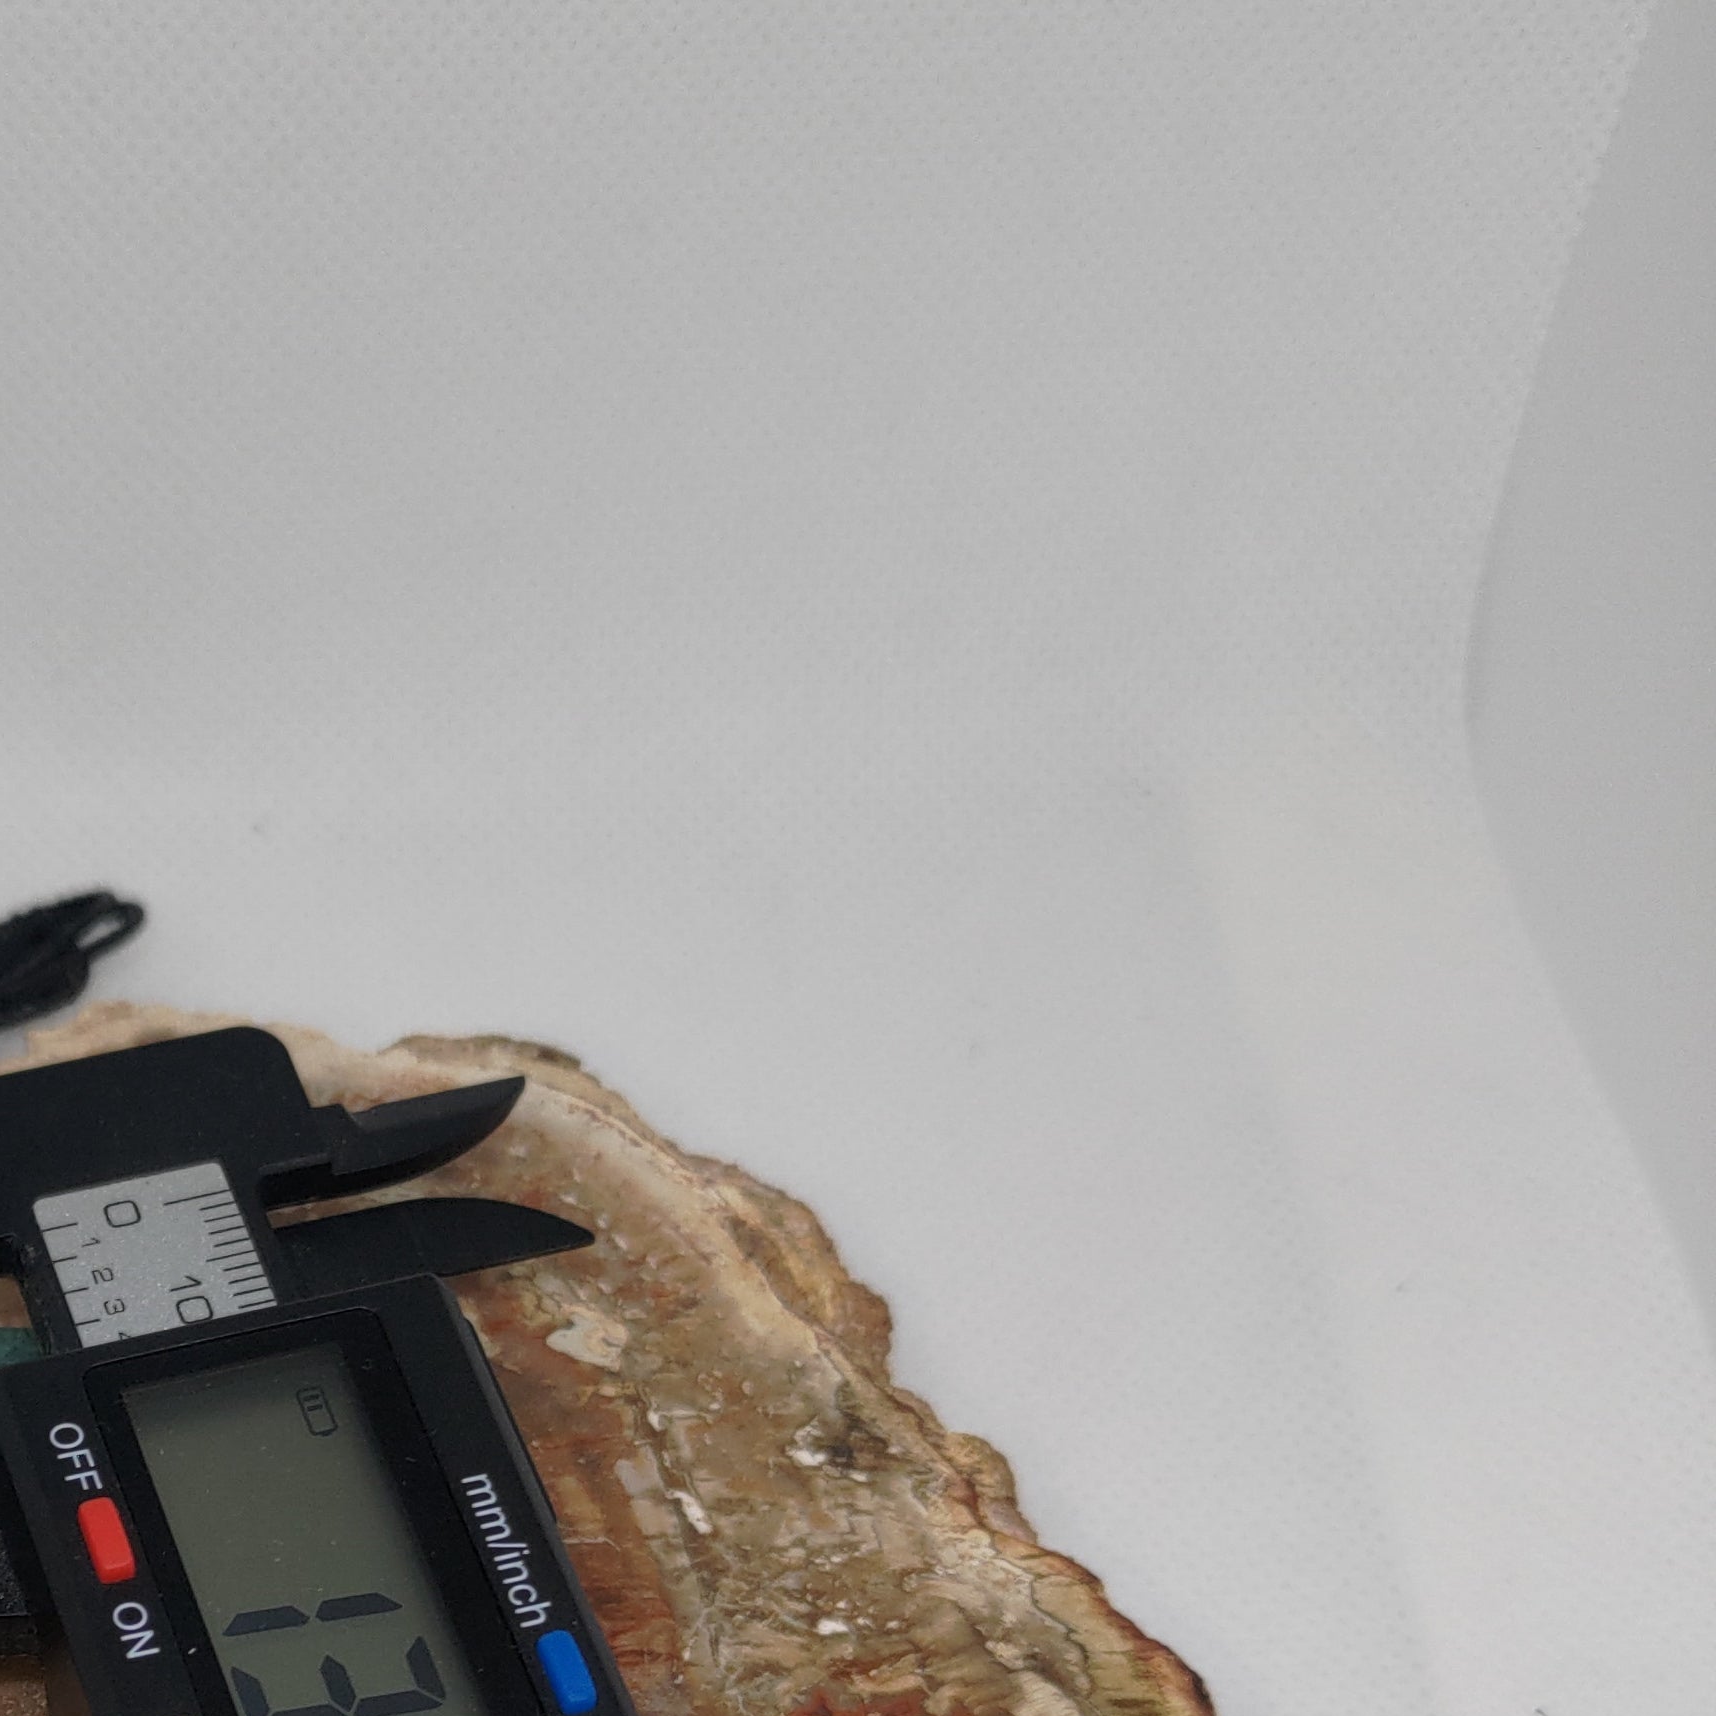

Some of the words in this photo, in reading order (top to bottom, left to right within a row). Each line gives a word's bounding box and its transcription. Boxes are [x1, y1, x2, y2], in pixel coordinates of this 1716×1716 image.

[82, 1238, 101, 1248] 1
[103, 1200, 142, 1228] 0
[169, 1276, 213, 1323] 10
[91, 1268, 114, 1285] 2
[103, 1299, 126, 1315] 3
[48, 1422, 103, 1491] OFF
[460, 1472, 550, 1630] mm/inch
[111, 1601, 161, 1661] ON
